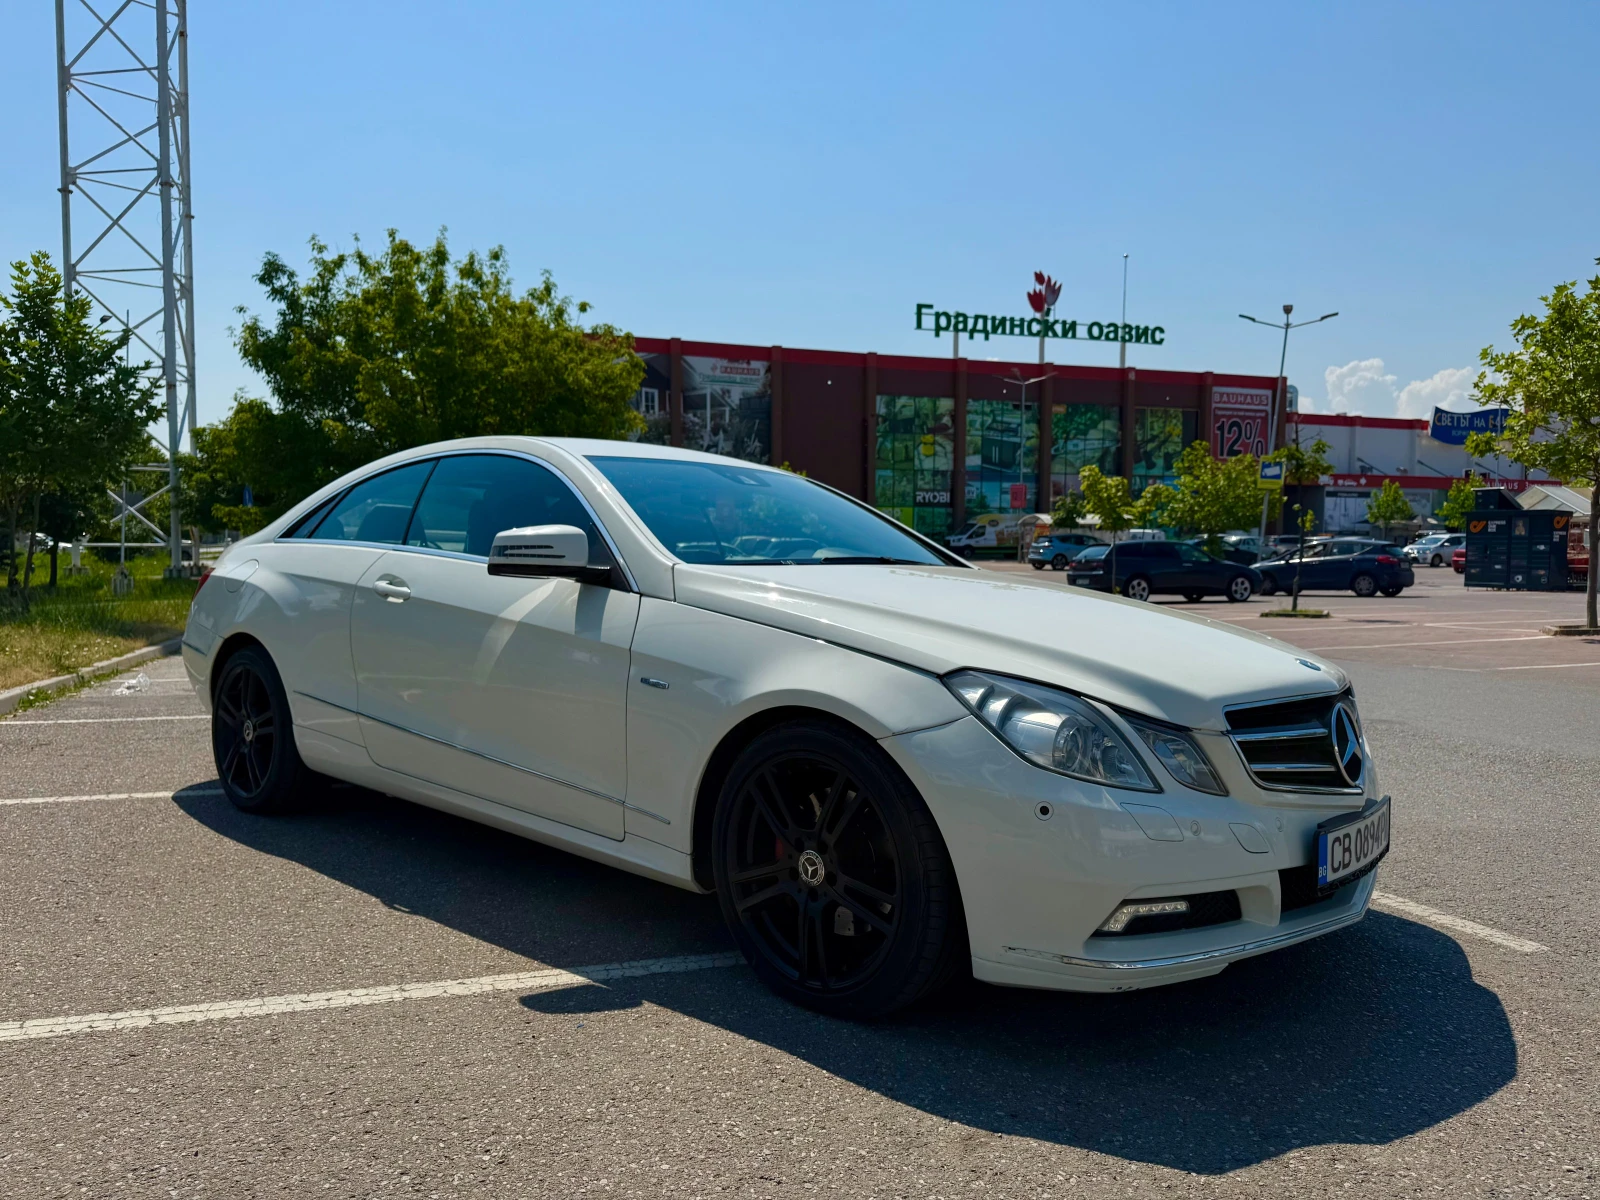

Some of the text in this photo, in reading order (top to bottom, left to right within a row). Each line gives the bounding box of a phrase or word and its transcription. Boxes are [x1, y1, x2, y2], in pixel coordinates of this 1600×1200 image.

[915, 303, 1165, 345] Градински оазис
[1213, 393, 1268, 405] BAUHAUS
[1435, 412, 1471, 427] СВЕТЪТ
[1474, 417, 1486, 428] НА
[1215, 418, 1264, 459] 12%
[915, 491, 950, 503] RYOBI
[1318, 866, 1327, 878] BG
